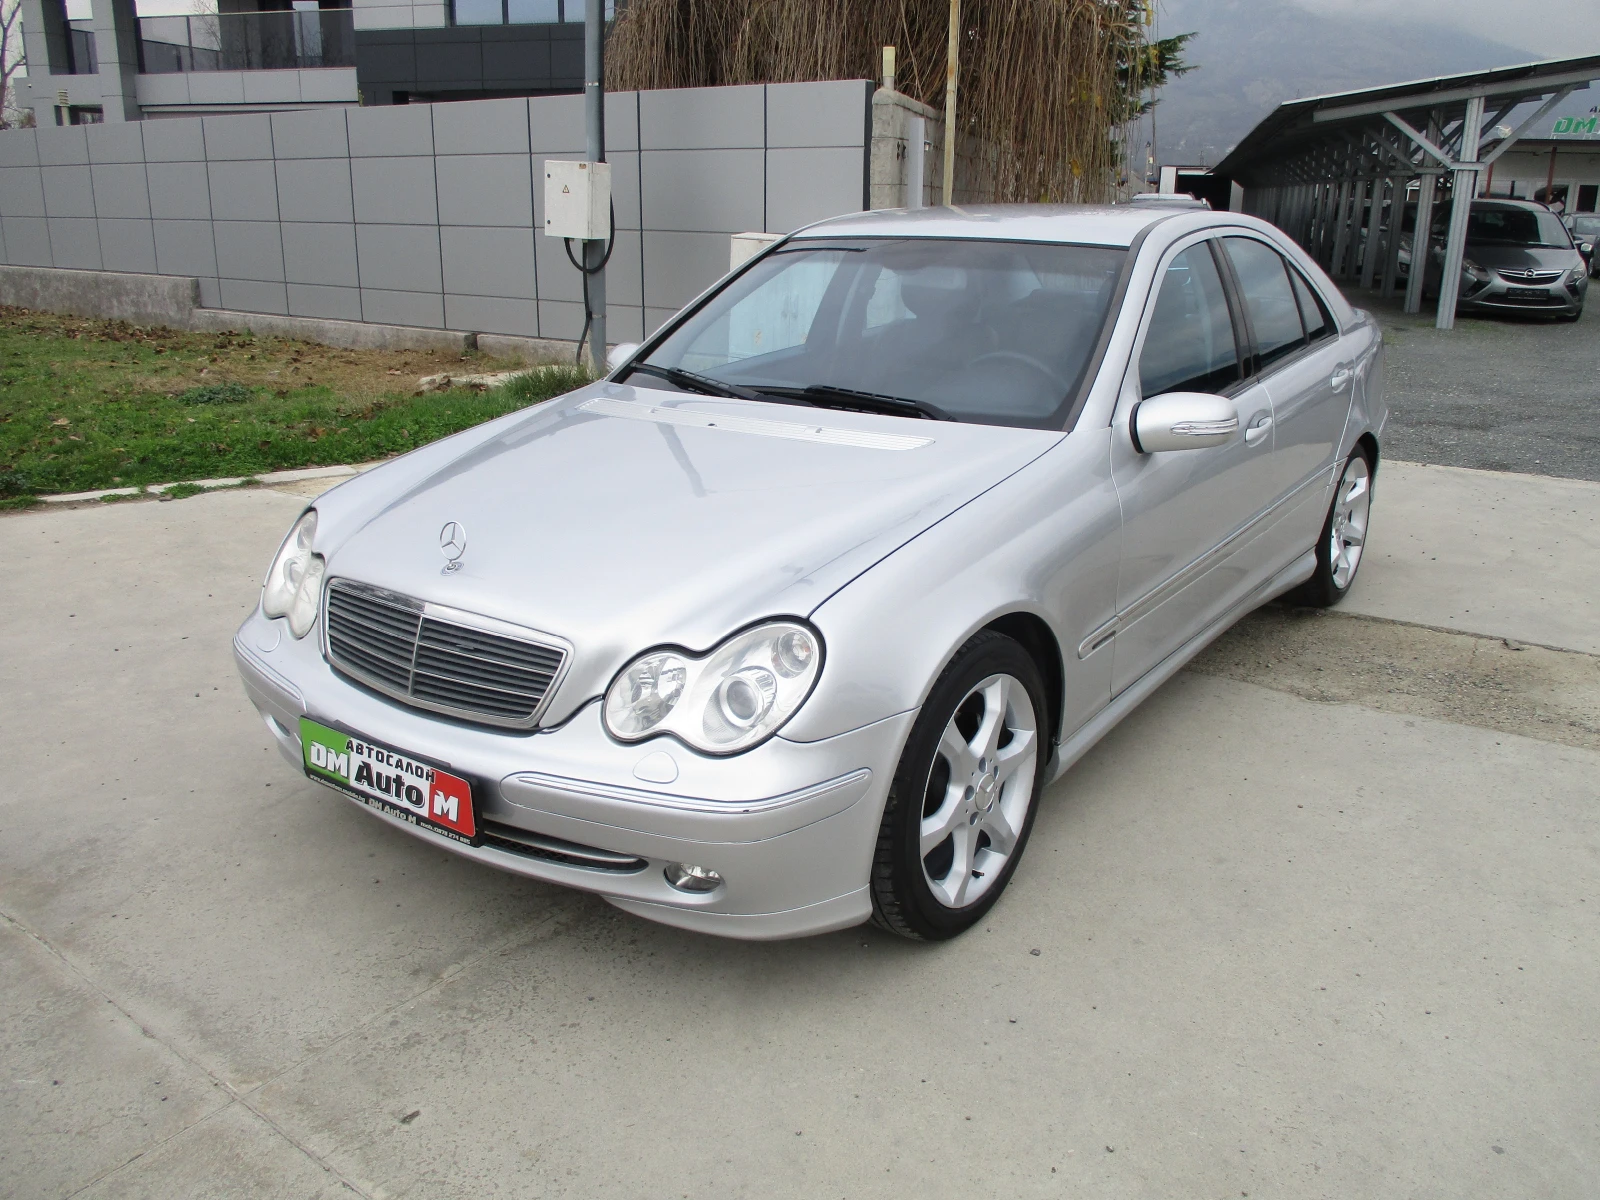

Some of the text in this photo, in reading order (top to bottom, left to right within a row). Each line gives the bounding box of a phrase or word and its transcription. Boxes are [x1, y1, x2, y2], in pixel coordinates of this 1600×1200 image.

[310, 741, 459, 823] DM Auto M
[346, 739, 436, 784] АВТОСАЛОН
[368, 797, 383, 812] DM
[384, 804, 407, 820] Auto
[408, 814, 417, 826] M
